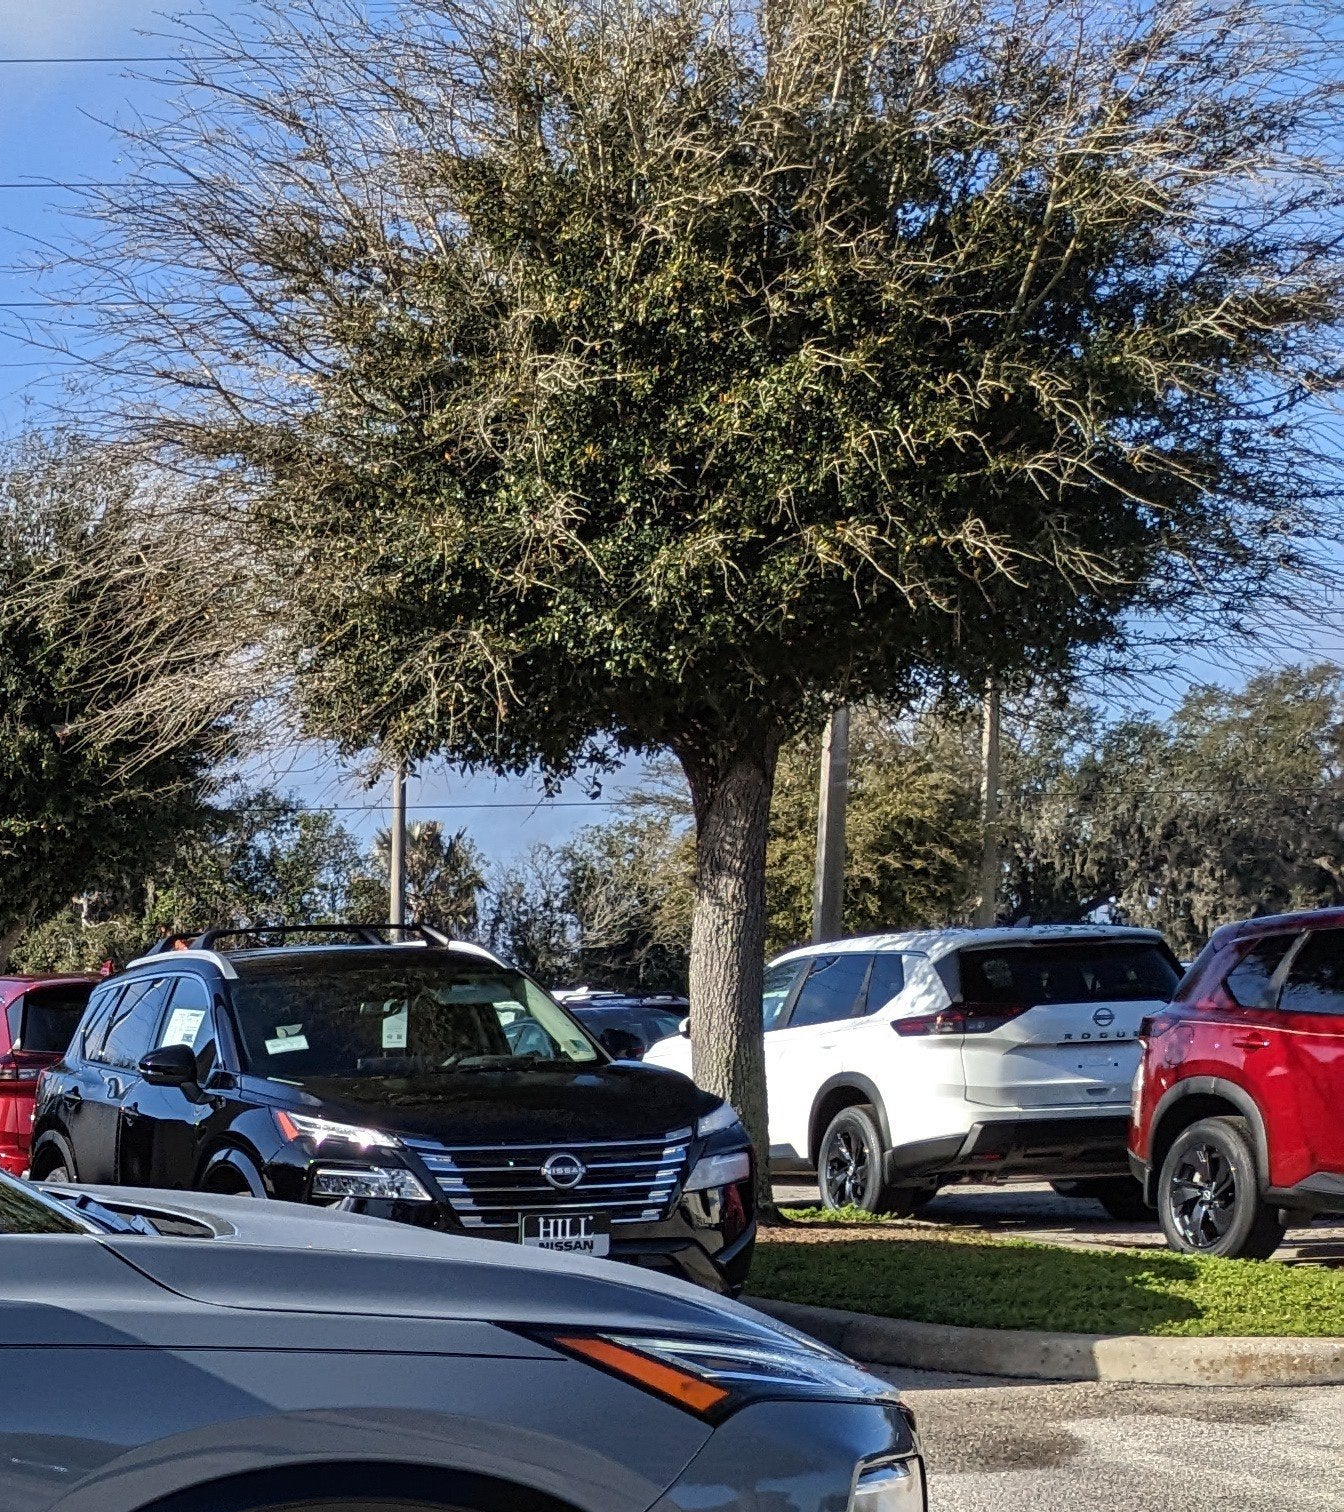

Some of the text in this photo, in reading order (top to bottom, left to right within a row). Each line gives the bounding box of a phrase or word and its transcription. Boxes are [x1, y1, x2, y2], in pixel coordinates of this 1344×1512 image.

[541, 1165, 586, 1176] NISSAN
[539, 1216, 594, 1241] HILL
[539, 1240, 594, 1252] NISSAN
